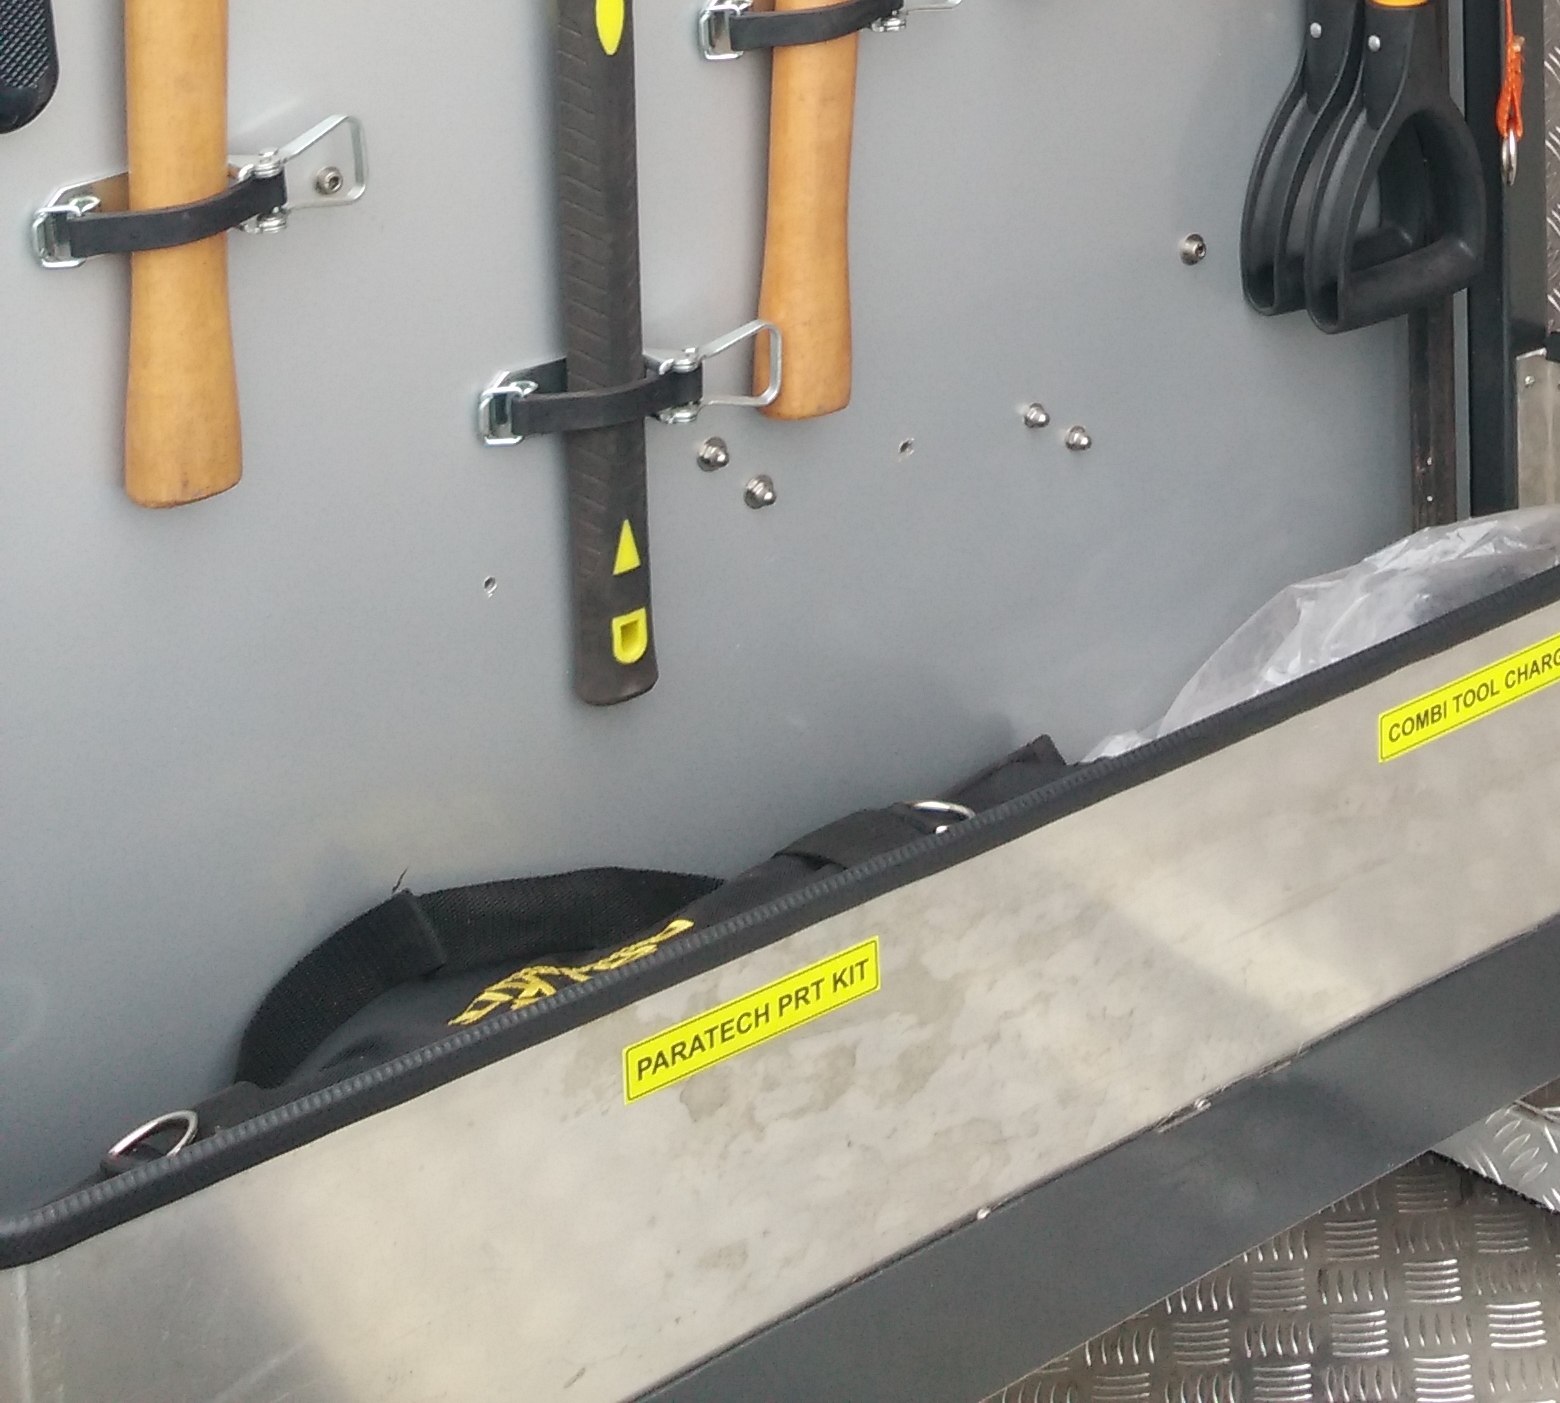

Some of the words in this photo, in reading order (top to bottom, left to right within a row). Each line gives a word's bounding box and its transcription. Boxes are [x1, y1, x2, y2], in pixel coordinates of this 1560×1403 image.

[1388, 700, 1448, 743] COMBI
[1452, 678, 1501, 714] TOOL
[637, 1002, 770, 1081] PARATECH
[778, 976, 826, 1018] PRT
[832, 958, 869, 994] KIT
